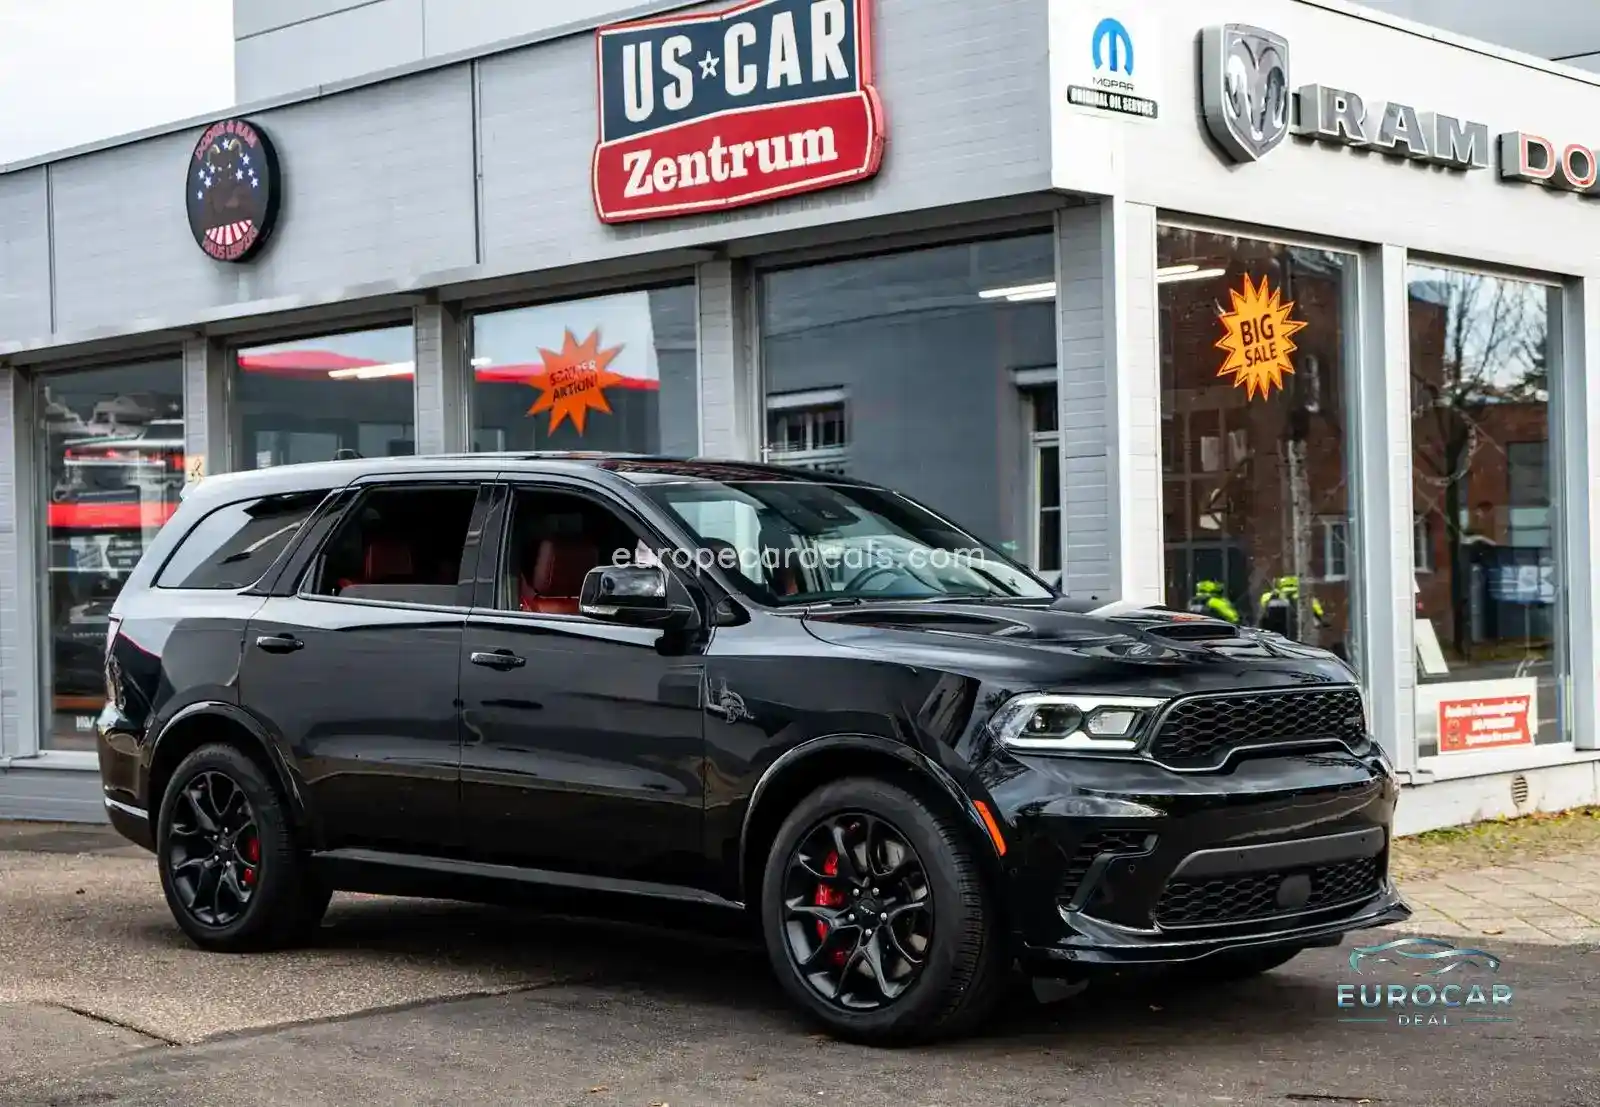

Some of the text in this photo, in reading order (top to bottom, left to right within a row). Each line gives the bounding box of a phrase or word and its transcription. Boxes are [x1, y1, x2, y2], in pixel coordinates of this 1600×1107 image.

[623, 0, 849, 122] US CAR
[1092, 77, 1135, 91] MOPAR
[623, 126, 838, 198] Zentrum
[1317, 84, 1598, 188] RAM DO
[1240, 314, 1274, 347] BIG
[1245, 342, 1277, 367] SALE
